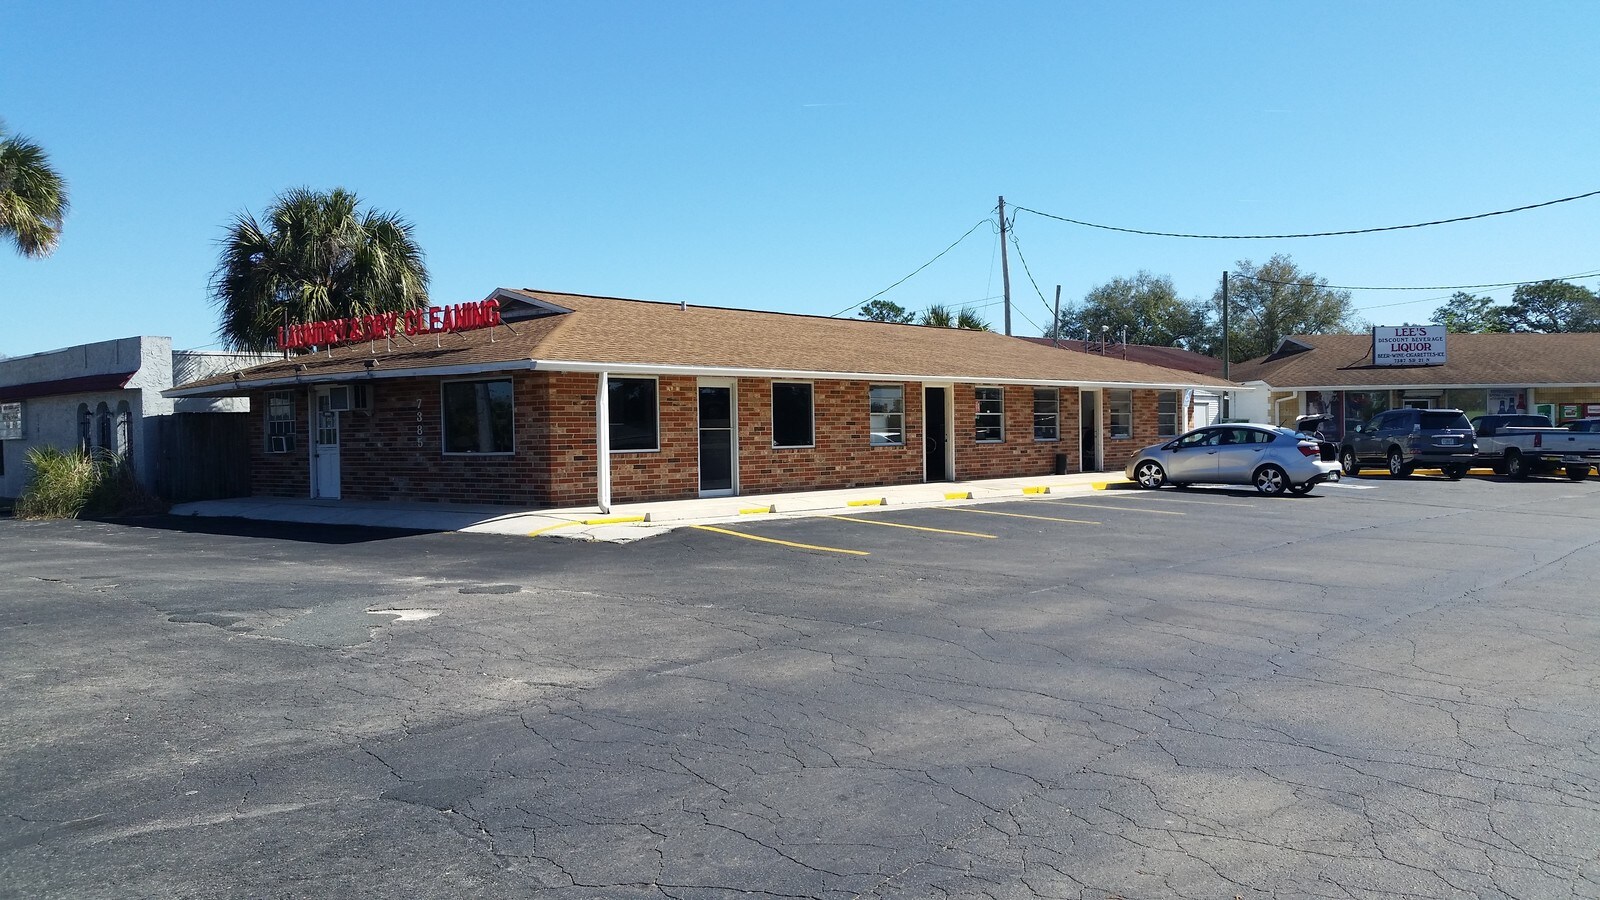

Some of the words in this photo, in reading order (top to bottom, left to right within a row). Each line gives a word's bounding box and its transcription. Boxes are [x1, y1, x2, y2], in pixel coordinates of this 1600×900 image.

[278, 318, 348, 349] LAUNDRY
[405, 298, 500, 336] CLEANING
[1395, 328, 1427, 337] LEE'S
[1391, 343, 1432, 352] LIQUOR
